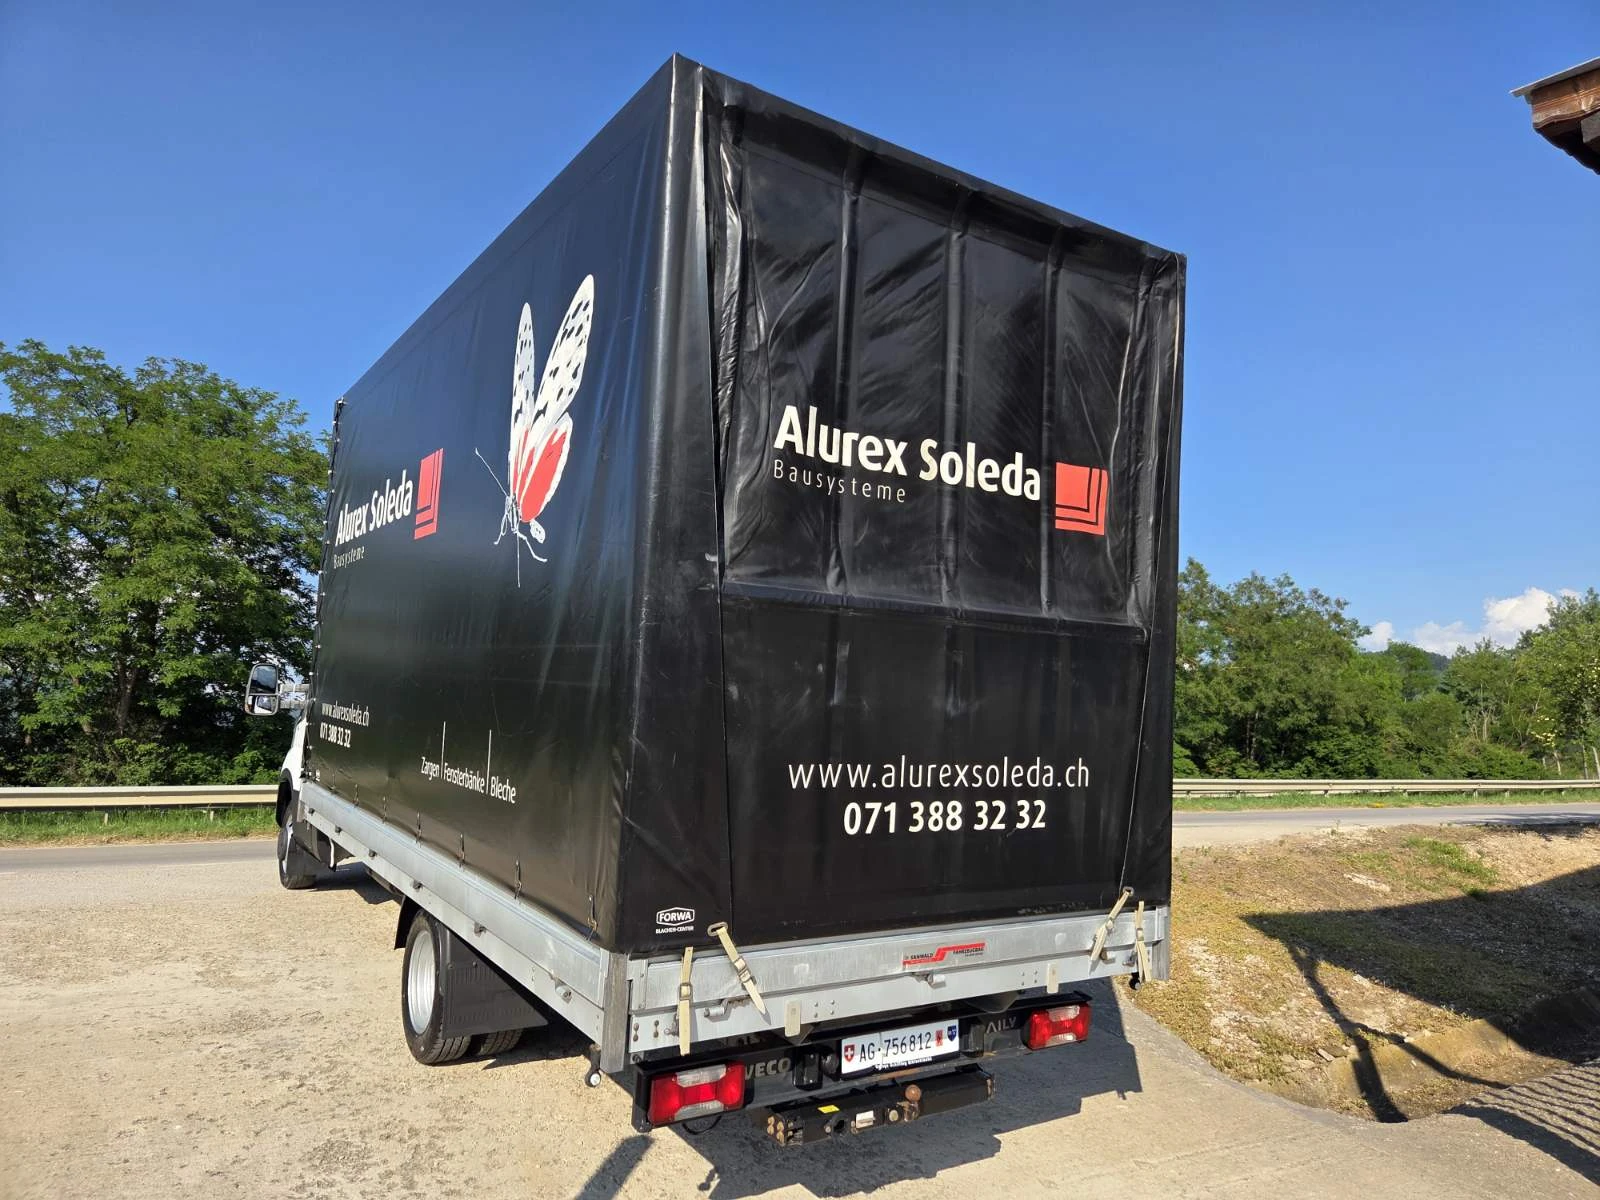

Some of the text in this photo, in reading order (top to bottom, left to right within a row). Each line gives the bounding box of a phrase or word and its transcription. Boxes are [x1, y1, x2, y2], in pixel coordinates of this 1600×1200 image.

[773, 405, 1041, 500] Alurex Soleda
[774, 459, 906, 503] Bausysteme
[334, 469, 413, 547] Alurex Soleda
[421, 756, 516, 804] Zargen Fensterbänke Bleche
[788, 755, 1090, 789] www.alurexsoleda.ch
[843, 799, 1046, 835] 071 388 32 32
[659, 911, 691, 922] FORWA
[986, 1016, 1017, 1034] AILY
[744, 1057, 792, 1081] VECO
